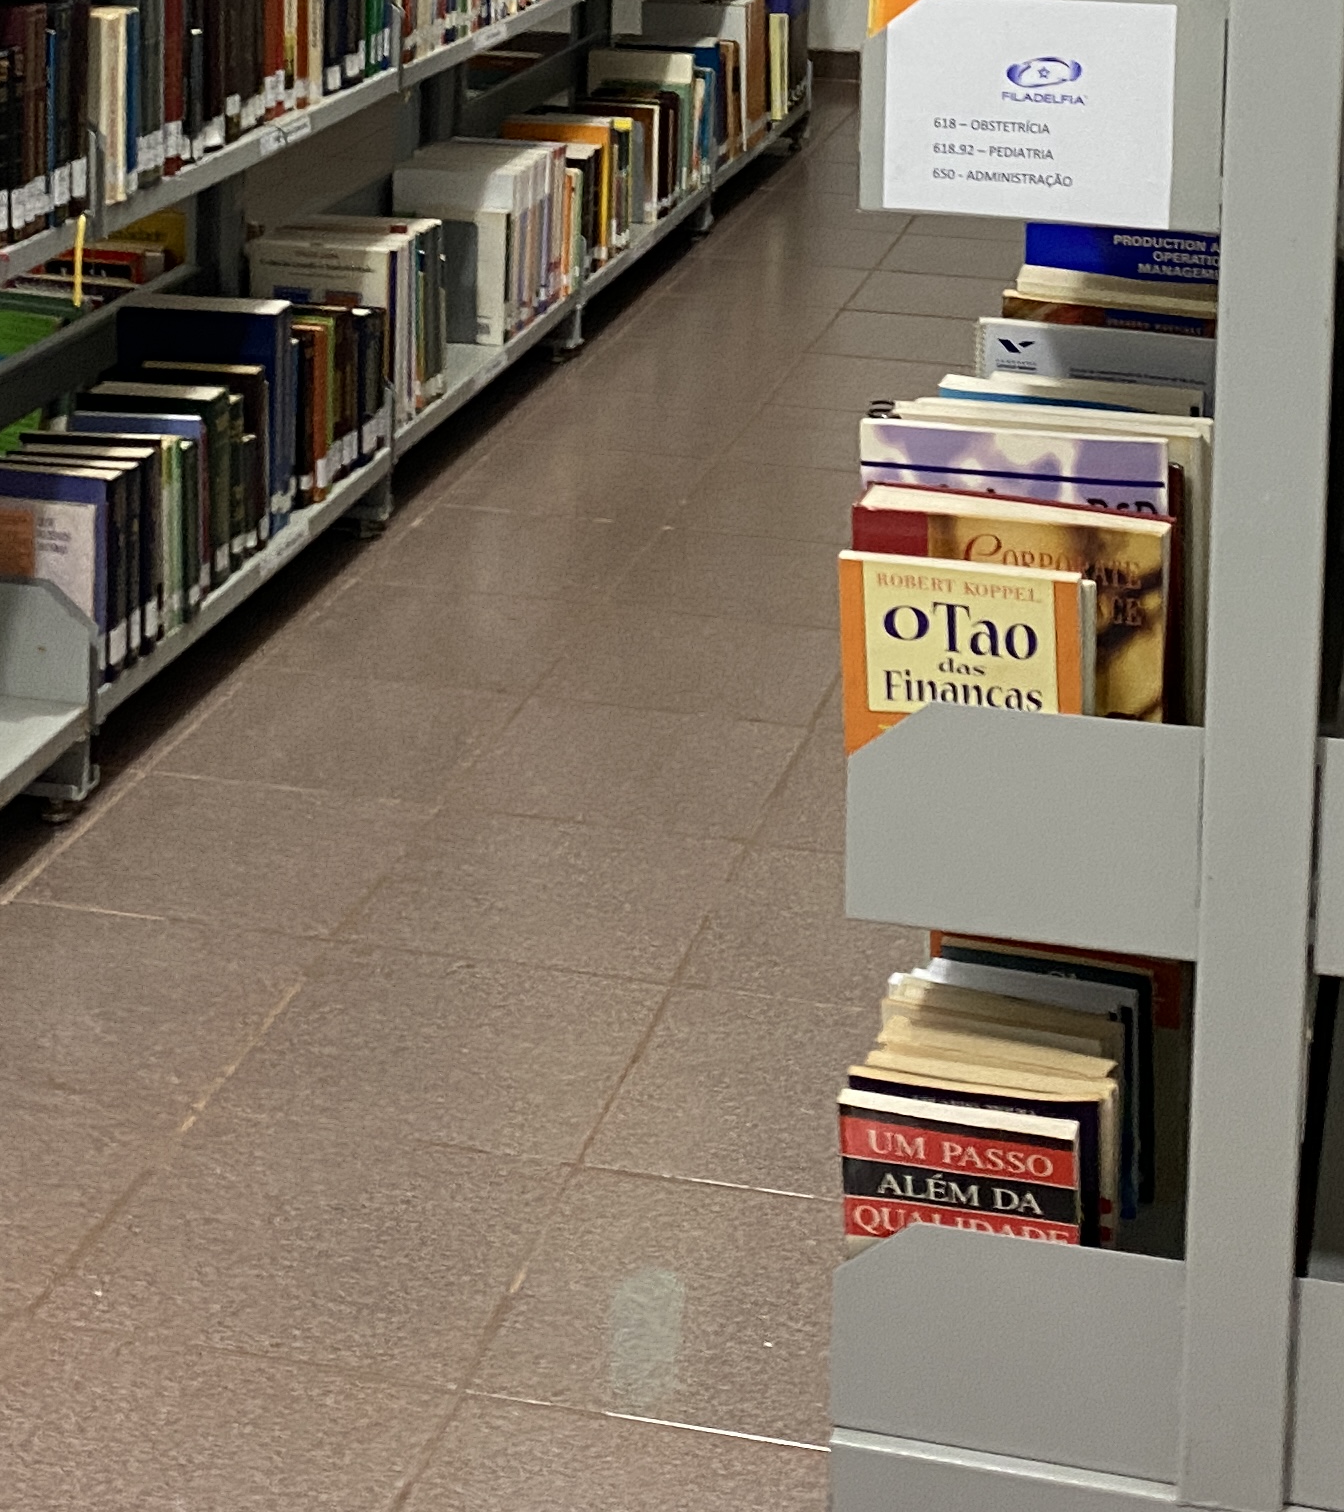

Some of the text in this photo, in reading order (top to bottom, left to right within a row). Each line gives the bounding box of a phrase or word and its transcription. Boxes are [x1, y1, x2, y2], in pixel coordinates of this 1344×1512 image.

[1002, 92, 1085, 105] FILADELFIA
[934, 118, 1050, 134] 618 OBSTETRÍCIA
[934, 143, 1054, 160] 618.92 PEDIATRIA
[933, 168, 1073, 187] 650 ADMINISTRAÇÃO
[1114, 235, 1206, 252] PRODUCTION
[876, 572, 1042, 603] ROBERT KOPPEL
[932, 601, 1038, 660] Tao
[938, 657, 987, 676] das
[867, 1129, 1054, 1178] UM PASSO
[877, 1172, 1044, 1216] ALÉM DA
